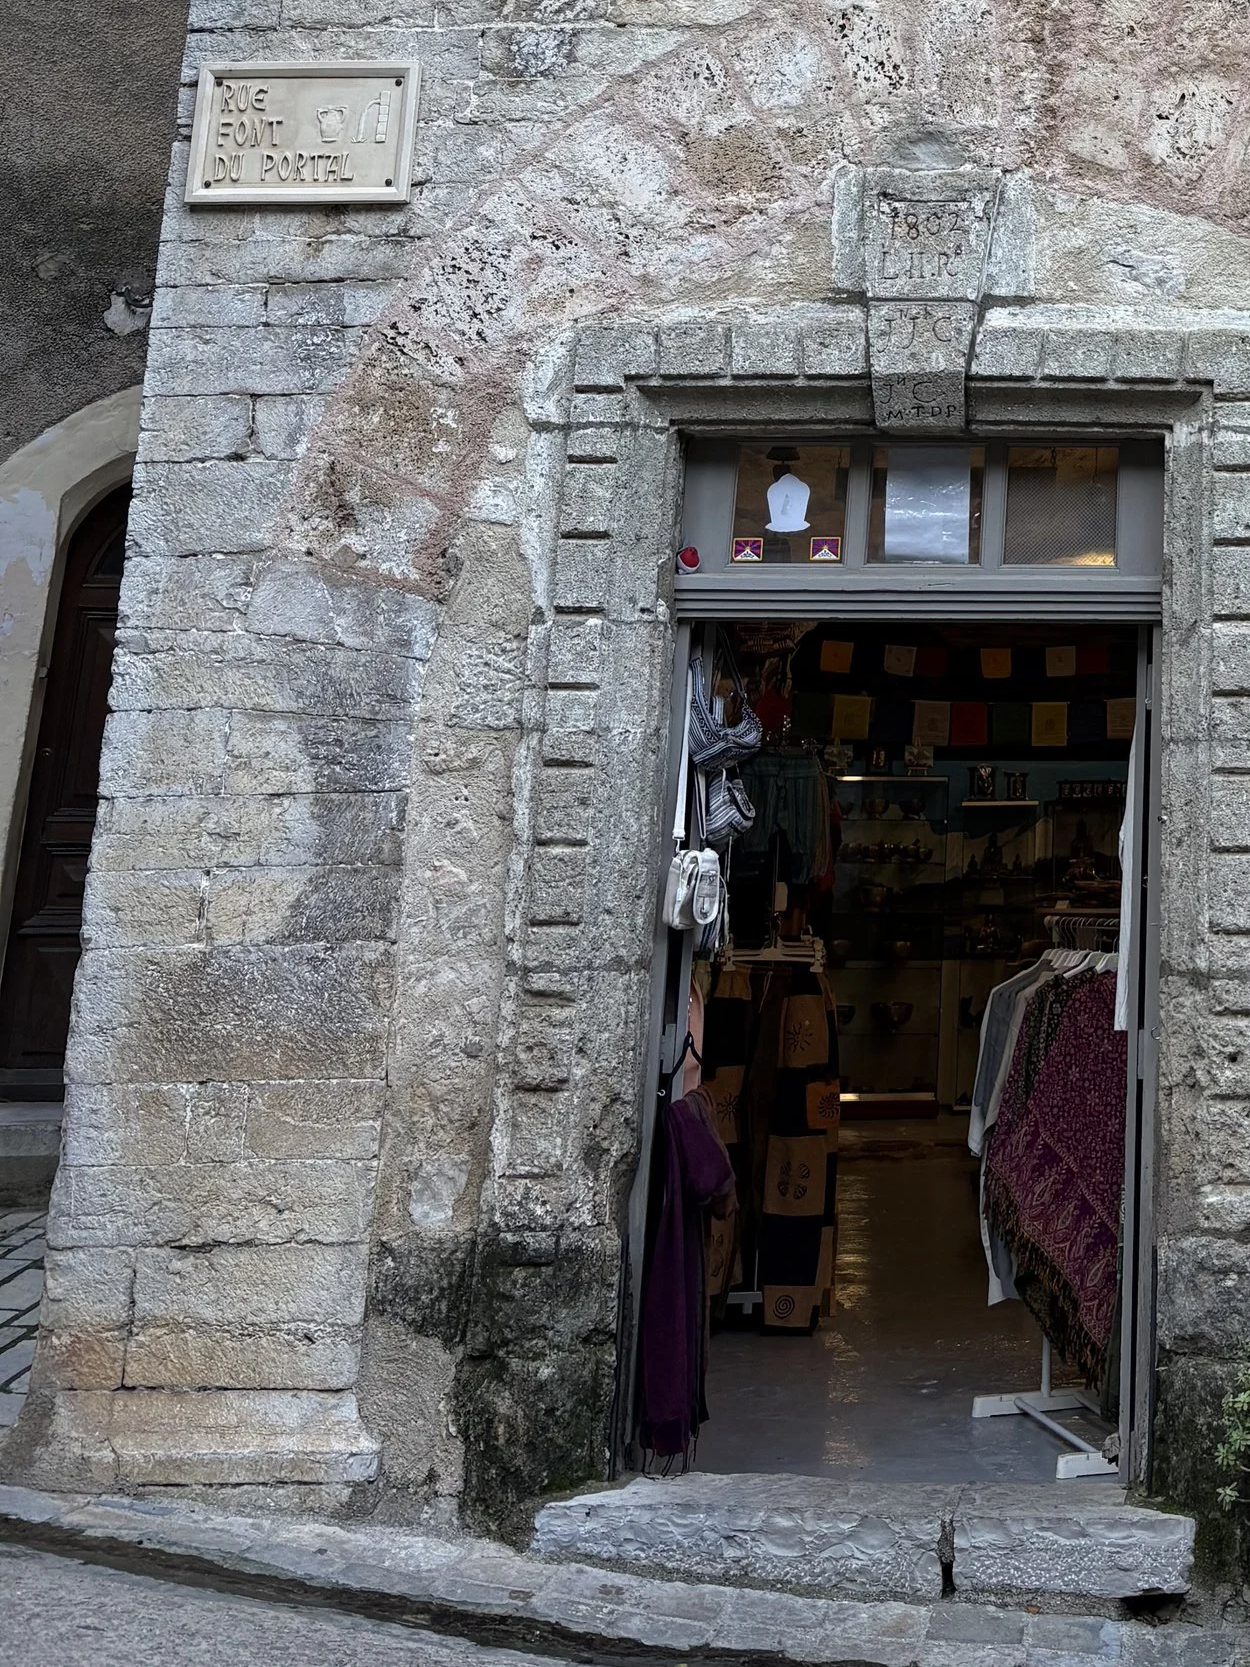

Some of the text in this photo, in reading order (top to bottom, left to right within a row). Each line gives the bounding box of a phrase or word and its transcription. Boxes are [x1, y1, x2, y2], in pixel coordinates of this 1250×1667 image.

[220, 84, 269, 113] RUE
[217, 116, 284, 148] FONT
[213, 152, 354, 182] DU PORTAL
